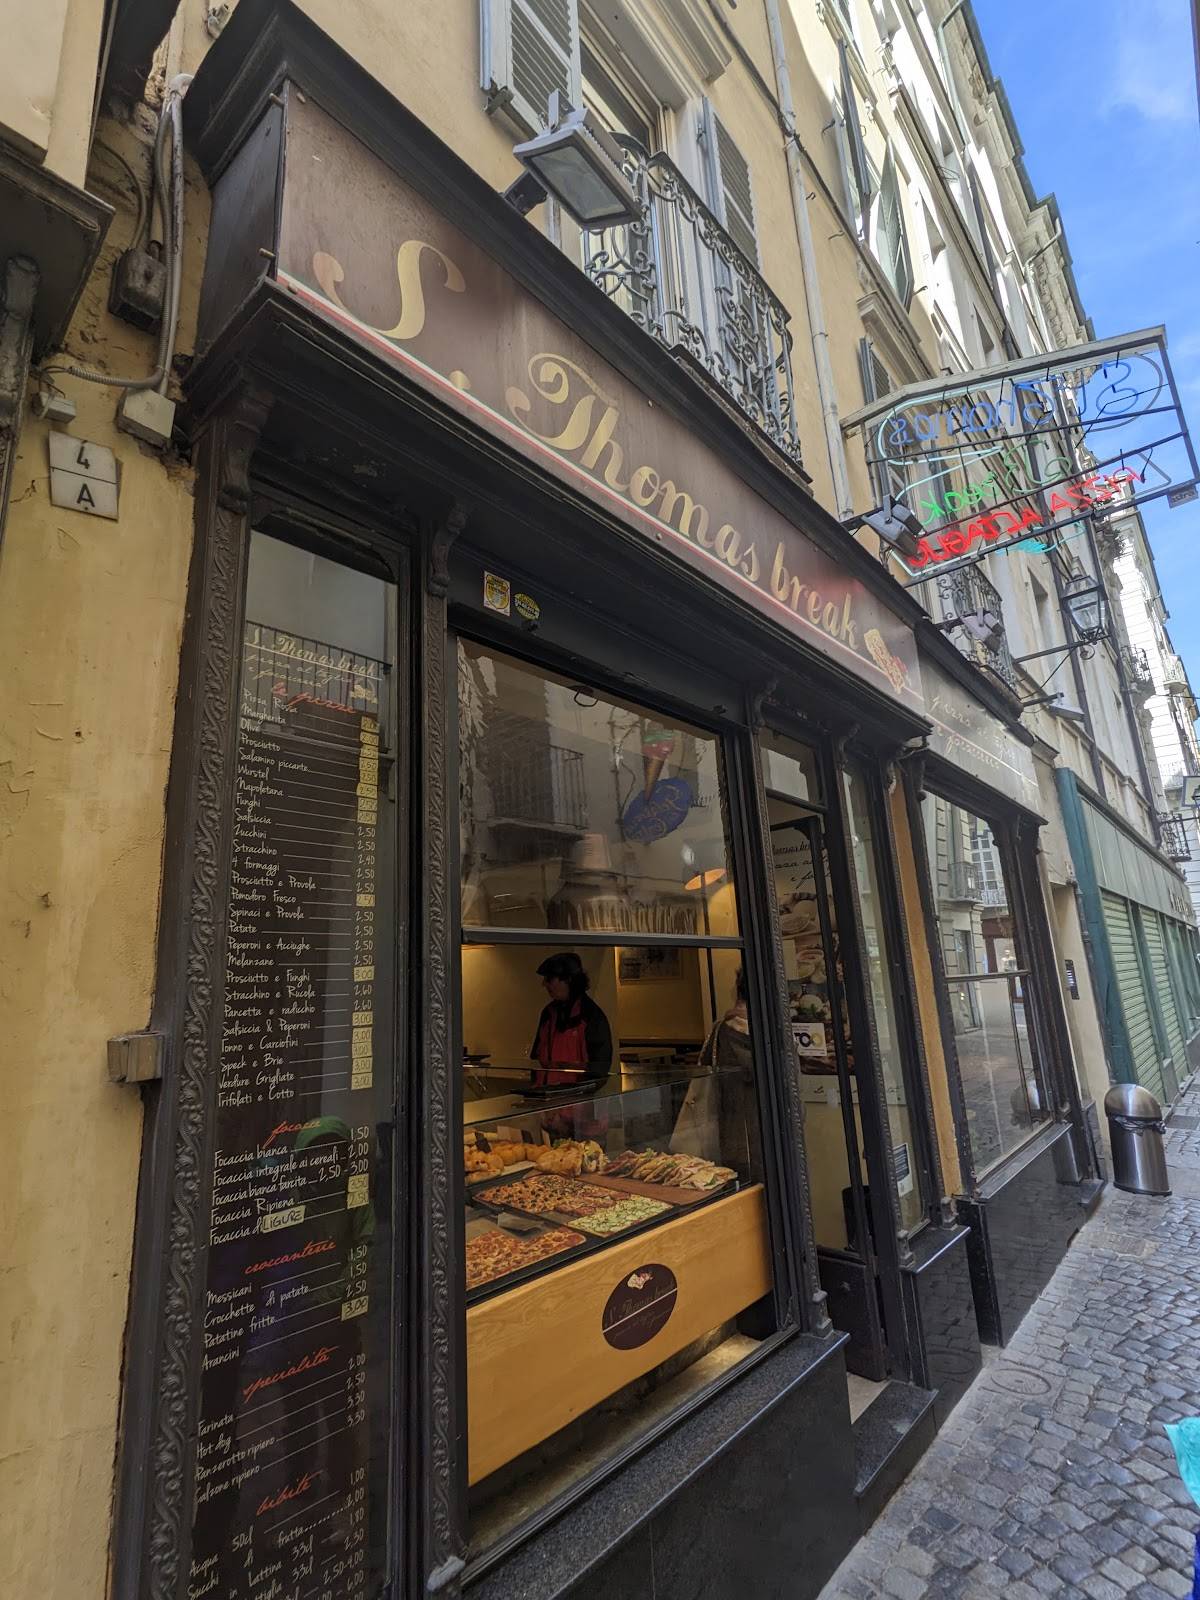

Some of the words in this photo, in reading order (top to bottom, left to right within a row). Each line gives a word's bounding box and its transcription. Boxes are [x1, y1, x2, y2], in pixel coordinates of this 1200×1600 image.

[77, 446, 90, 469] 4
[77, 483, 95, 507] A
[505, 352, 761, 583] Thomas
[771, 540, 859, 651] break
[277, 635, 334, 666] Thomas
[338, 656, 376, 676] break
[241, 703, 286, 725] Margherita
[241, 734, 280, 751] Prosciutto
[239, 747, 275, 765] Salamino
[278, 760, 309, 772] piccante
[238, 764, 269, 780] Wurstel
[236, 777, 284, 796] Napoletana
[236, 792, 260, 813] Funghi
[234, 808, 272, 825] Salsiccia
[358, 827, 376, 838] 2,50
[233, 823, 267, 839] Zucchini
[358, 841, 376, 852] 2,50
[233, 839, 277, 856] Stracchino
[358, 855, 375, 866] 2,40
[232, 856, 238, 868] 4
[244, 857, 280, 876] formaggi
[356, 868, 375, 880] 2,50
[231, 871, 274, 887] Prosciutto
[288, 875, 316, 890] Provola
[356, 883, 375, 893] 2,50
[230, 887, 267, 902] Pomodoro
[273, 890, 297, 903] Fresco
[229, 903, 261, 922] Spinaci
[276, 905, 305, 919] Provola
[355, 911, 374, 922] 2,50
[228, 920, 257, 934] Patate
[355, 925, 374, 937] 2,50
[227, 936, 261, 955] Peperoni
[276, 937, 311, 956] Acciughe
[355, 940, 373, 951] 2,50
[227, 953, 275, 967] Melanzane
[354, 955, 373, 966] 2,50
[226, 970, 269, 983] Prosciutto
[286, 969, 310, 987] Funghi
[224, 987, 270, 1002] Stracchino
[286, 984, 316, 998] Rucola
[354, 985, 373, 996] 2,60
[224, 1004, 262, 1018] Pancetta
[281, 1001, 315, 1015] radicchio
[354, 1000, 372, 1011] 2,60
[222, 1020, 261, 1037] Salsiccia
[278, 1018, 311, 1036] Peperoni
[221, 1039, 243, 1053] Tonno
[248, 1043, 254, 1051] e
[259, 1035, 299, 1050] Carciofini
[220, 1055, 247, 1075] Speck
[252, 1060, 258, 1068] e
[263, 1053, 284, 1067] Brie
[219, 1074, 250, 1089] Verdure
[255, 1068, 295, 1088] Grigliate
[218, 1091, 252, 1108] Trifolati
[268, 1085, 295, 1100] Cotto
[214, 1150, 254, 1169] Focaccia
[257, 1144, 288, 1159] bianca
[350, 1126, 370, 1142] 1,50
[213, 1168, 253, 1187] Focaccia
[256, 1154, 298, 1182] integrale
[298, 1159, 308, 1169] ai
[309, 1146, 339, 1166] cereali
[348, 1142, 369, 1159] 2,00
[212, 1188, 247, 1207] Focaccia
[248, 1180, 277, 1198] bianca
[279, 1175, 307, 1193] farcita
[210, 1208, 252, 1227] Focaccia
[254, 1197, 295, 1215] Ripiena
[209, 1227, 250, 1246] Focaccia
[263, 1210, 303, 1231] LIGURE
[206, 1283, 252, 1307] Messicani
[350, 1245, 368, 1261] 1,50
[203, 1303, 256, 1329] Crocchette
[280, 1284, 310, 1309] patate
[350, 1263, 367, 1280] 1,50
[203, 1327, 244, 1349] Patatine
[346, 1280, 367, 1299] 2,50
[201, 1347, 240, 1371] Arancini
[346, 1300, 367, 1316] 3,00
[198, 1413, 234, 1437] Farinata
[348, 1353, 366, 1371] 2,00
[197, 1442, 212, 1460] Hot
[215, 1433, 231, 1455] dog
[346, 1372, 366, 1391] 2,50
[194, 1449, 246, 1481] Panzerotto
[247, 1436, 275, 1460] ripieno
[194, 1480, 230, 1505] Calzone
[231, 1465, 260, 1489] ripieno
[190, 1553, 219, 1577] Acqua
[231, 1525, 254, 1552] 50cl
[350, 1467, 364, 1487] 1,00
[249, 1559, 282, 1587] Lattina
[187, 1571, 219, 1600] Succhi
